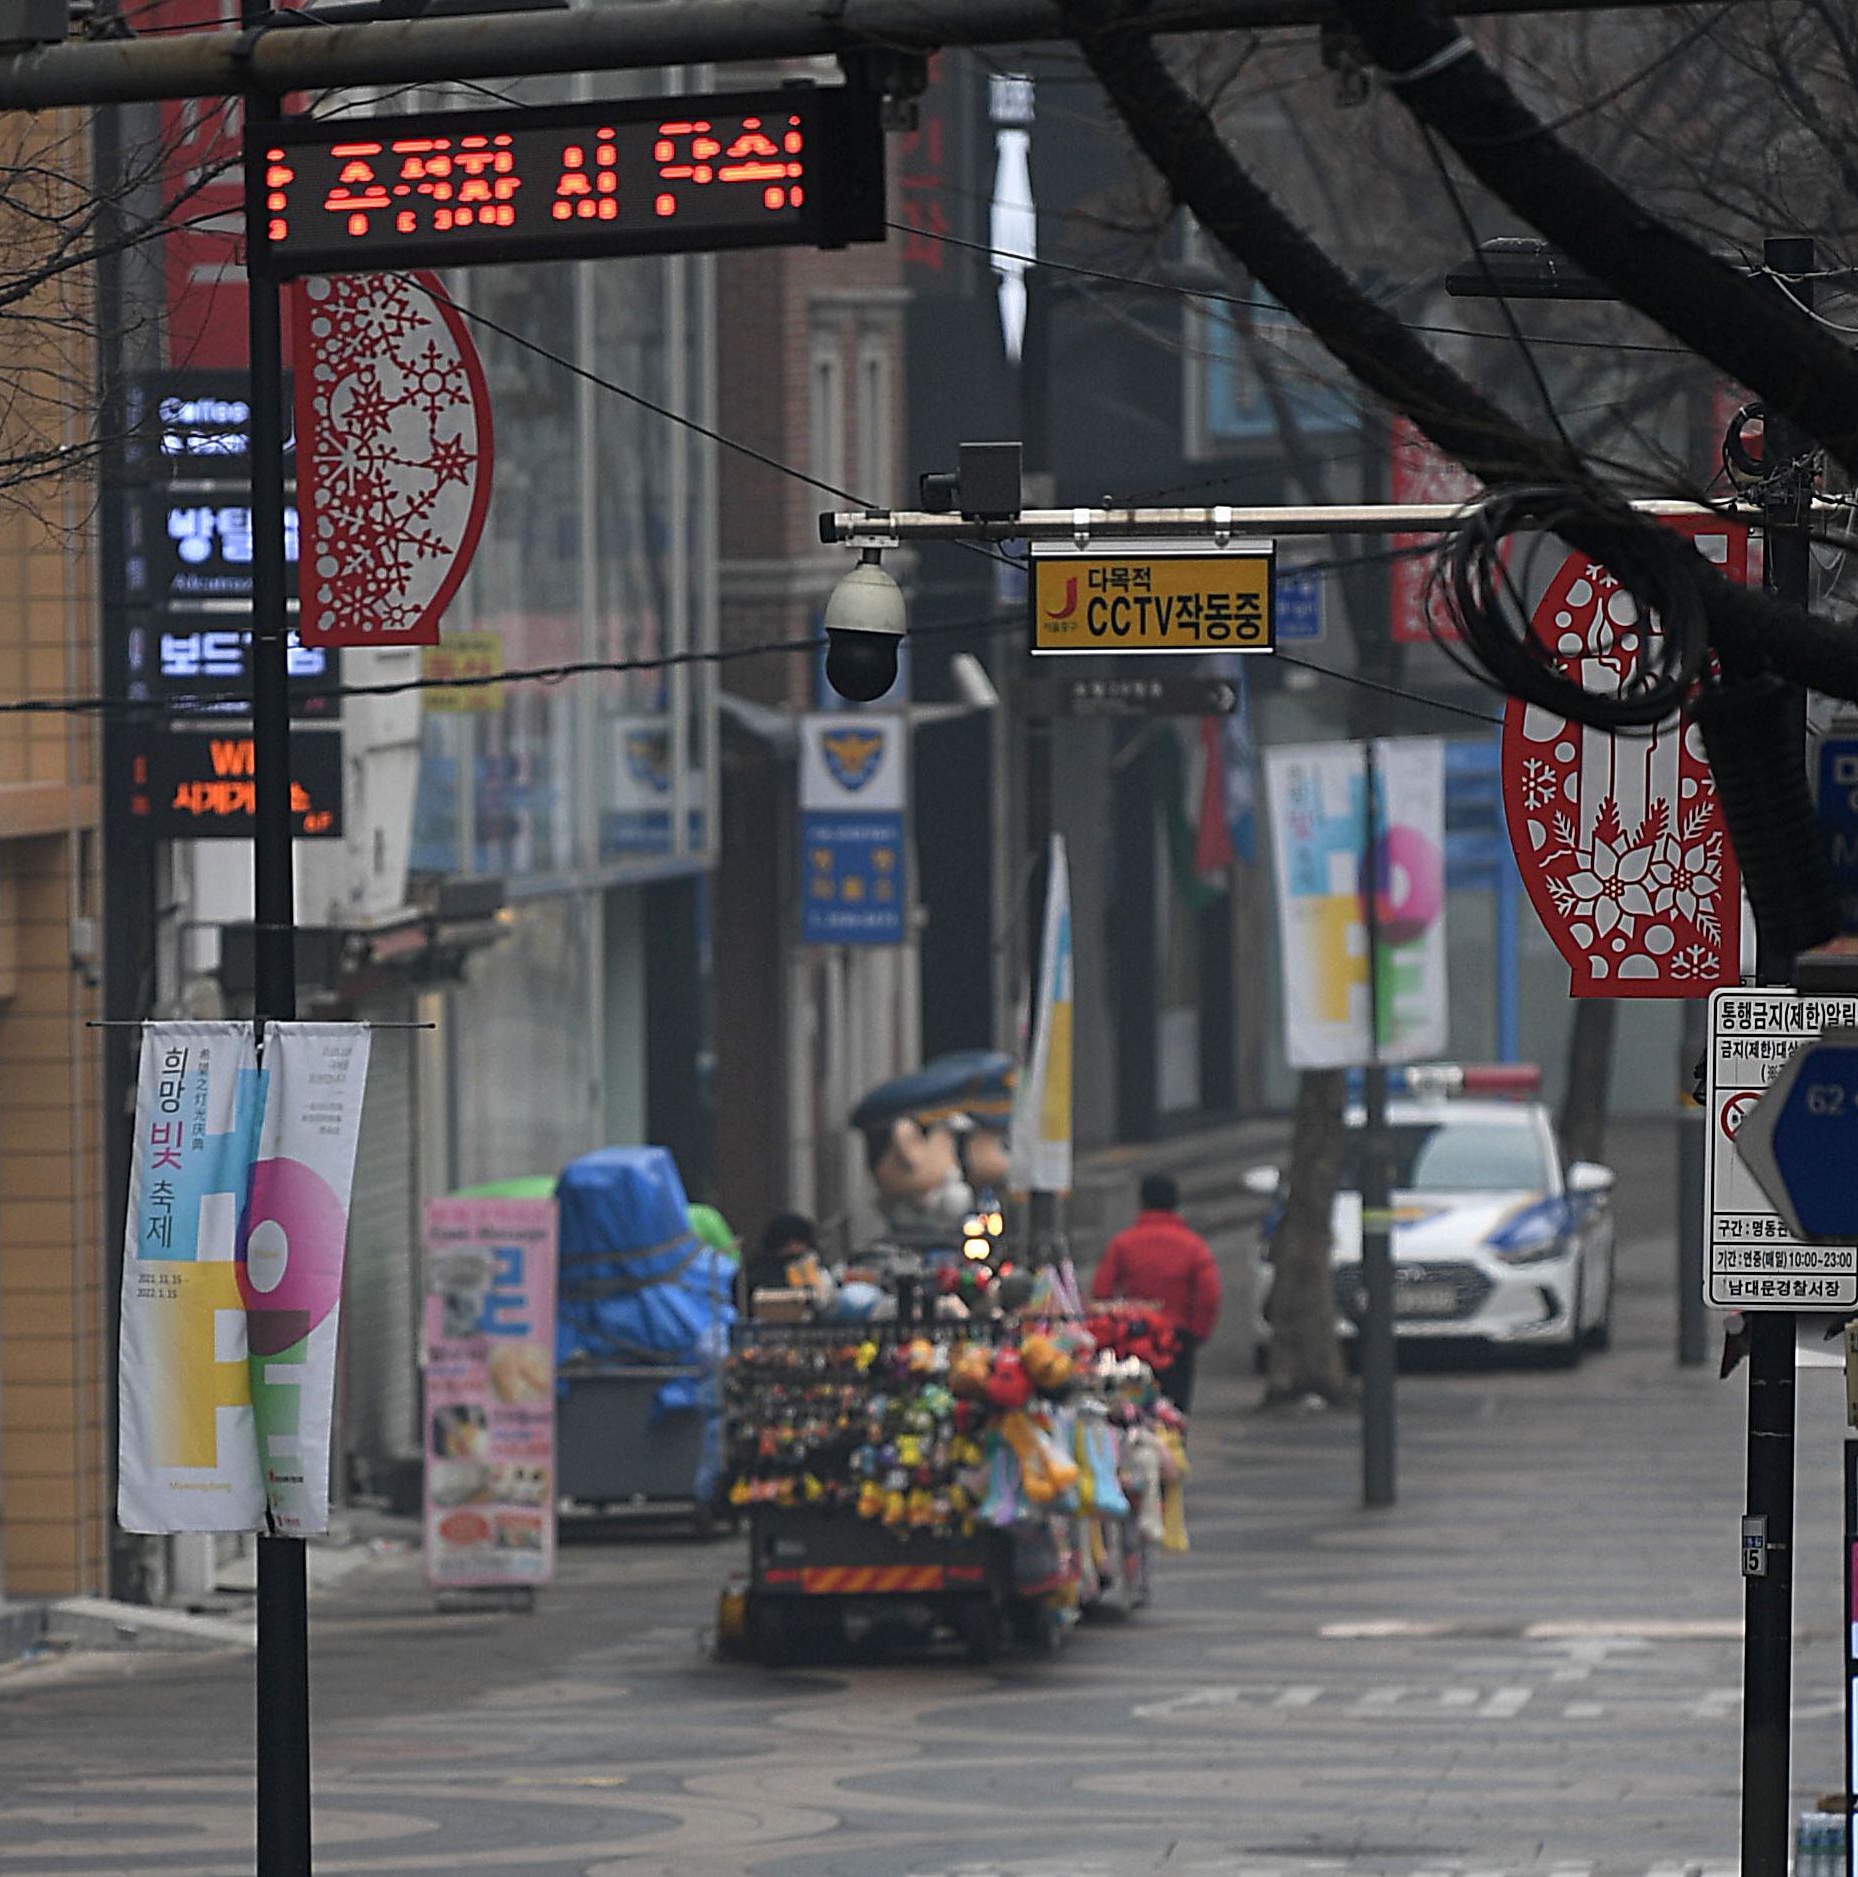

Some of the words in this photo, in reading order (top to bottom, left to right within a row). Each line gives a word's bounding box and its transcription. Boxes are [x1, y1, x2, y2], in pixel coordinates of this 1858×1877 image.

[1087, 566, 1151, 593] 다목적
[1807, 1084, 1846, 1116] 62
[149, 1120, 184, 1171] 빛
[145, 1178, 176, 1249] 축제
[1728, 1280, 1841, 1298] 남대문경찰서장
